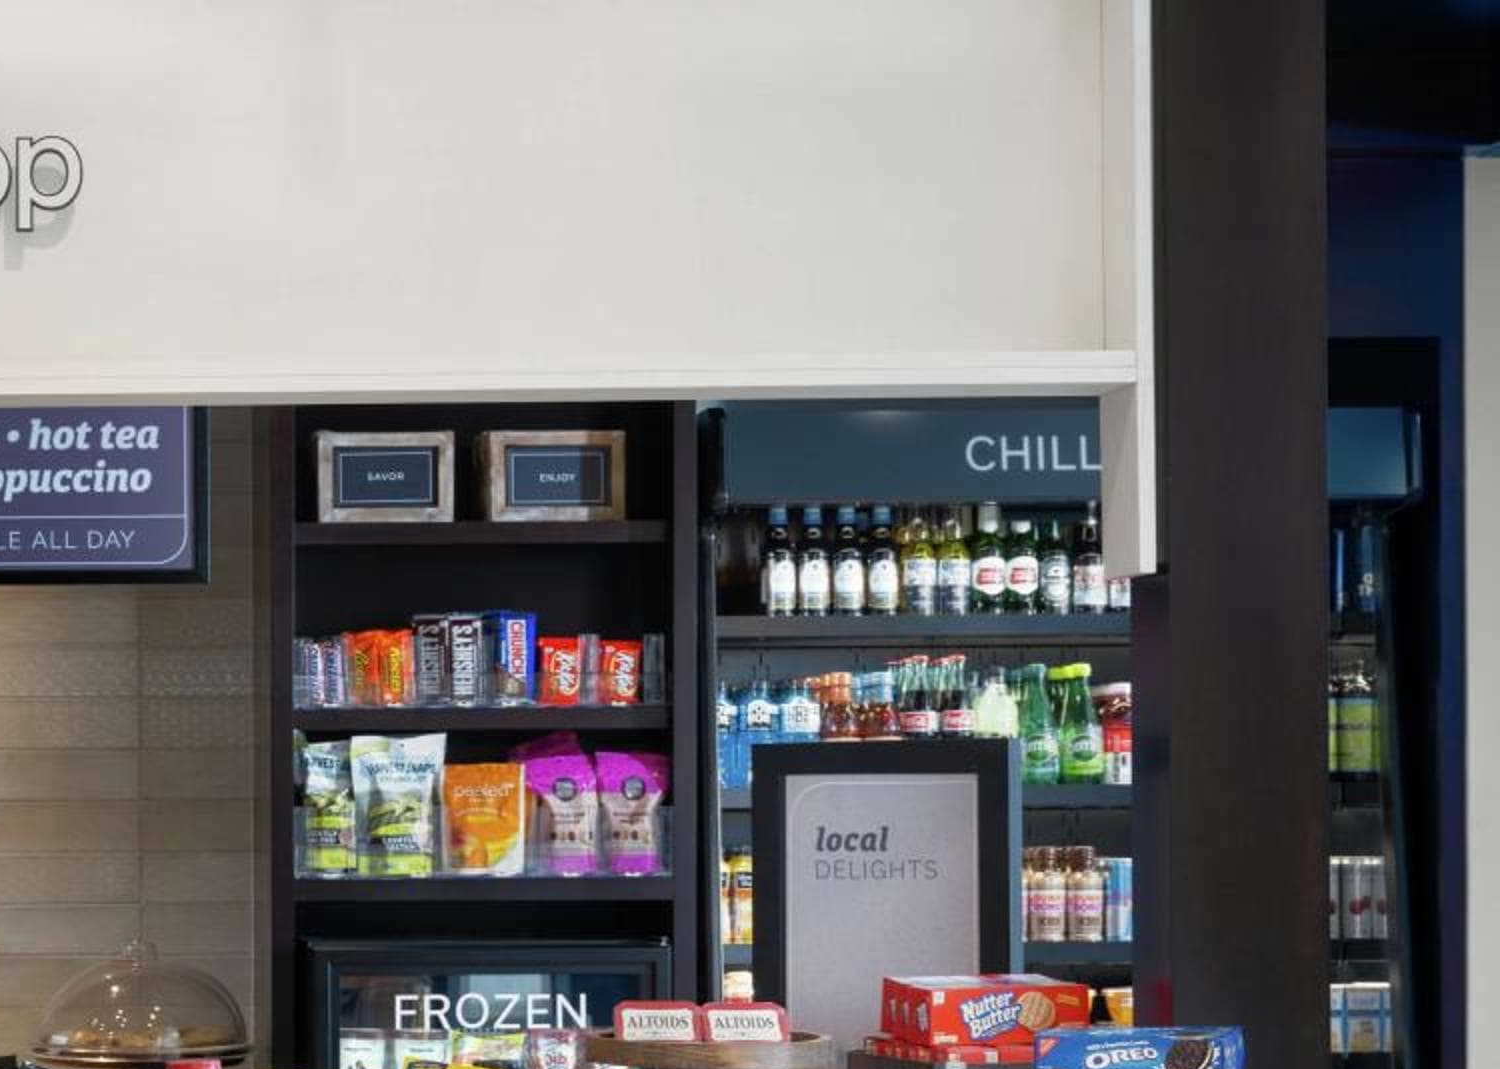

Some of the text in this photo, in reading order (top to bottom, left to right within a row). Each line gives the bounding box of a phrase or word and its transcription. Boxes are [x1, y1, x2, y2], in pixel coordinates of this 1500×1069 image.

[28, 419, 92, 450] hot
[100, 422, 161, 450] tea
[367, 471, 405, 482] SAVOR
[539, 473, 577, 484] ENJOY
[31, 530, 78, 550] ALL
[86, 529, 136, 550] DAY
[815, 825, 889, 852] local
[814, 858, 939, 881] DELIGHTS
[394, 992, 588, 1031] FROZEN
[961, 991, 1014, 1023] Nutter
[626, 1015, 690, 1031] ALTOIDS
[713, 1015, 777, 1031] ALTOIDS
[970, 1004, 1021, 1040] Butter
